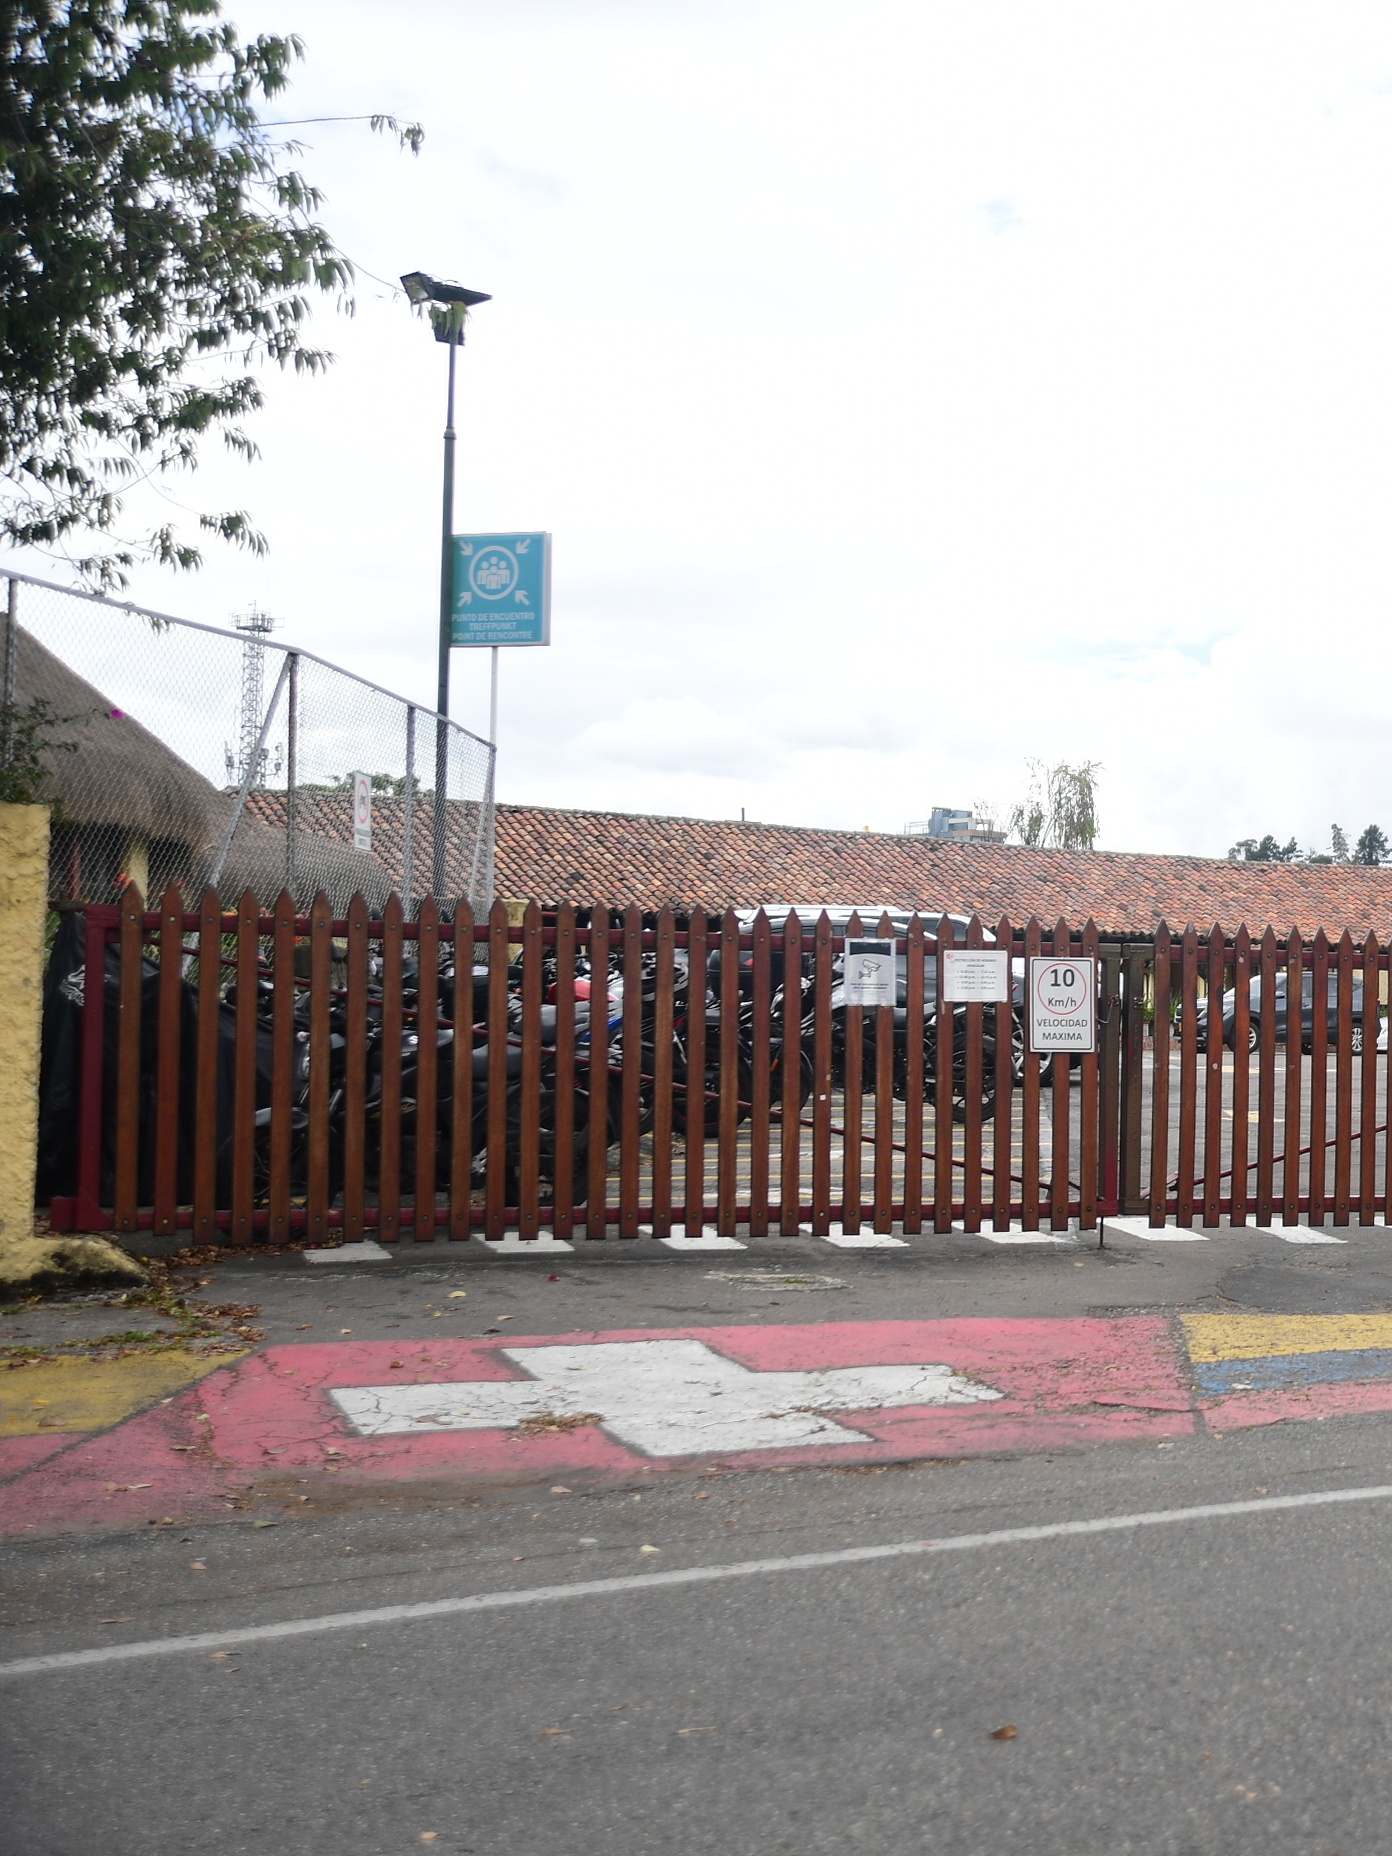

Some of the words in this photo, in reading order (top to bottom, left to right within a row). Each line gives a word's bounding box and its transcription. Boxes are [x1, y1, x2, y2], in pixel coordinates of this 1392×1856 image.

[451, 613, 476, 622] PUNTO
[478, 613, 488, 621] DE
[490, 612, 535, 620] ENCUENTRO
[469, 622, 517, 631] TREFFPUNKT
[452, 632, 475, 641] POINT
[476, 632, 487, 640] DE
[488, 631, 533, 640] RENCONTRE
[1050, 969, 1075, 987] 10
[1048, 997, 1077, 1009] Km/h
[1037, 1018, 1088, 1027] VELOCIDAD
[1042, 1032, 1082, 1041] MAXIMA
